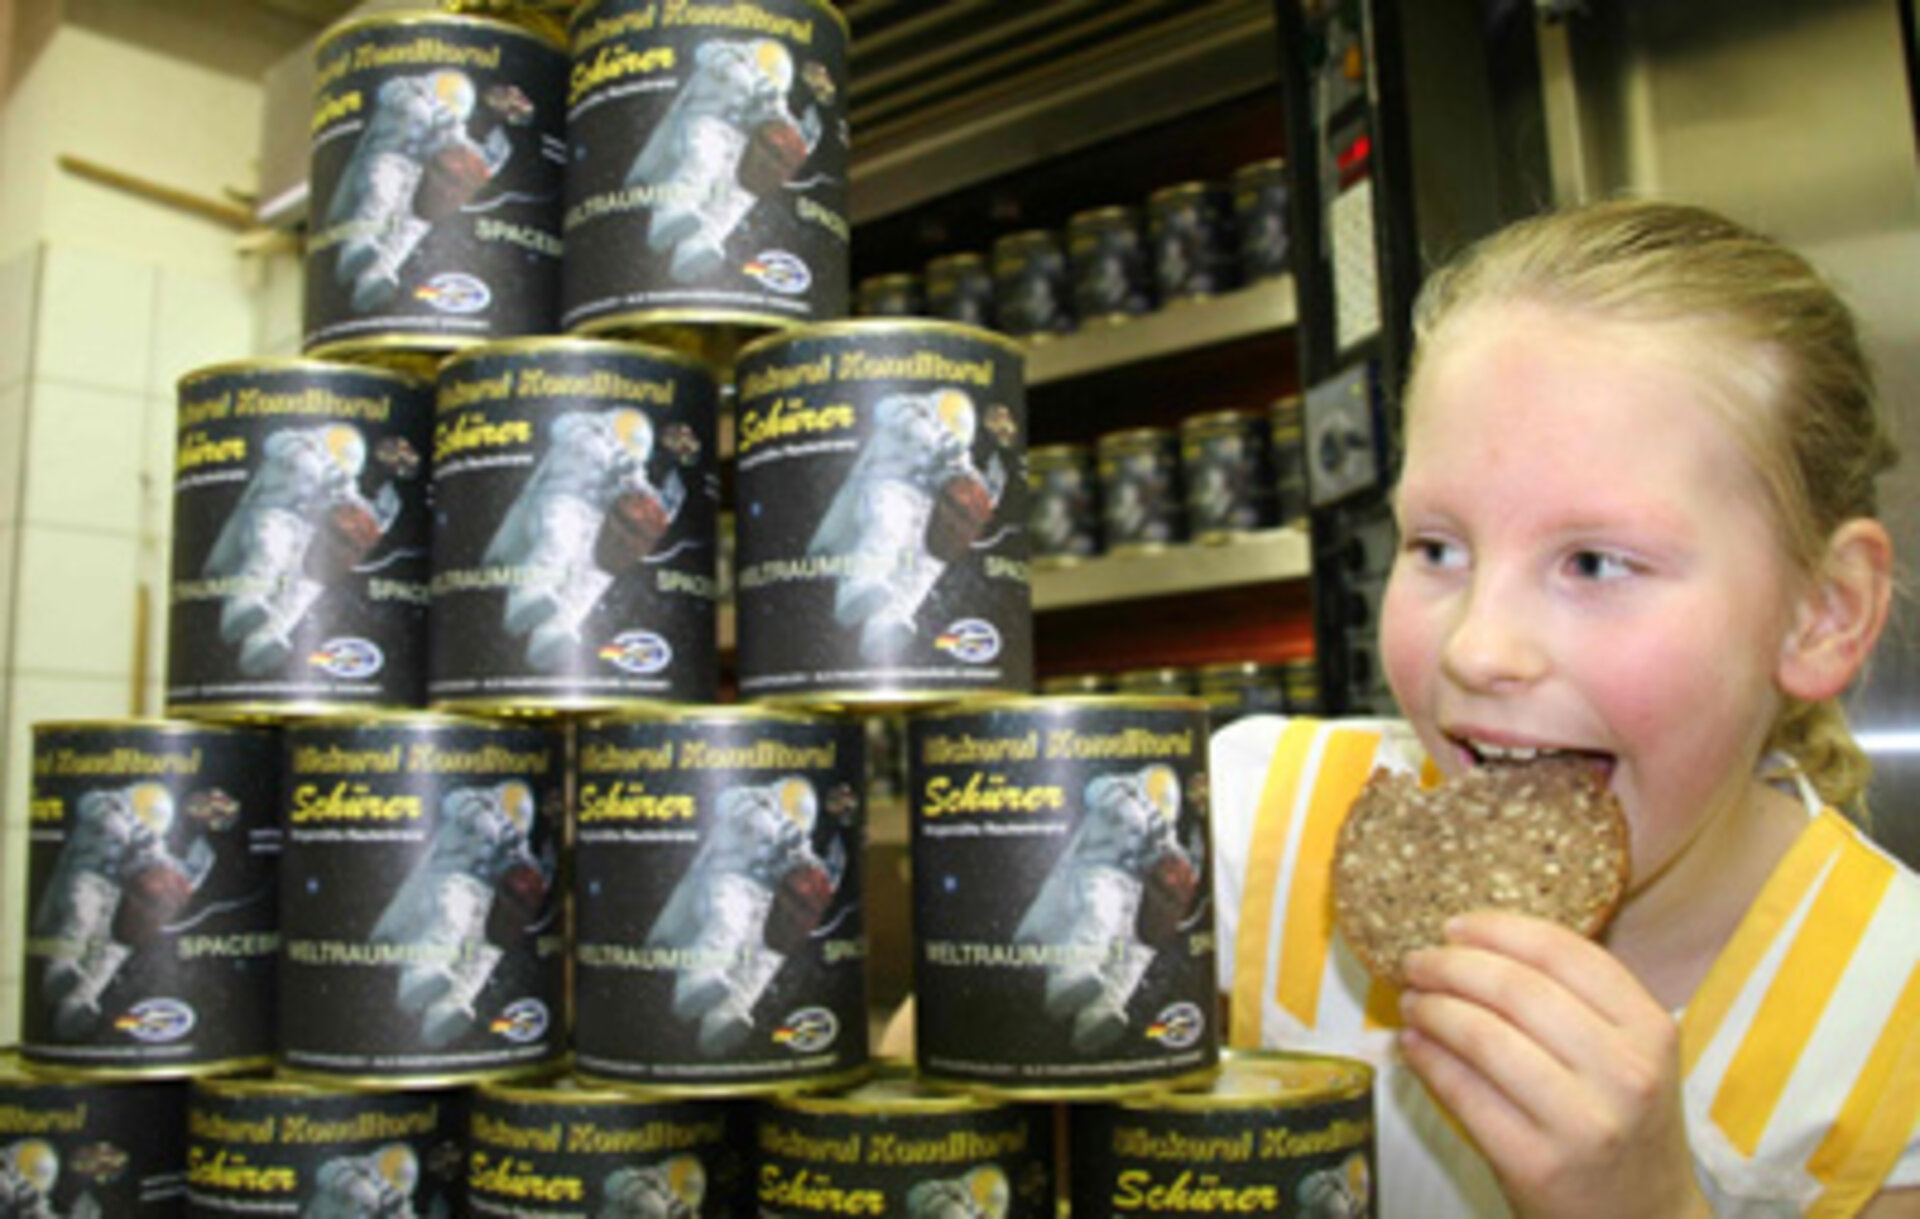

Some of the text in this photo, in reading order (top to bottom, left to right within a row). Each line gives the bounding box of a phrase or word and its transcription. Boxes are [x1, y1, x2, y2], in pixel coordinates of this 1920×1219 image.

[739, 398, 856, 451] Schürer
[292, 781, 422, 823] Schürer
[579, 781, 696, 822] Schürer
[922, 771, 1064, 818] Schürer
[468, 1153, 586, 1201] Schürer
[757, 1164, 887, 1215] Schürer
[1112, 1169, 1280, 1212] Schürer
